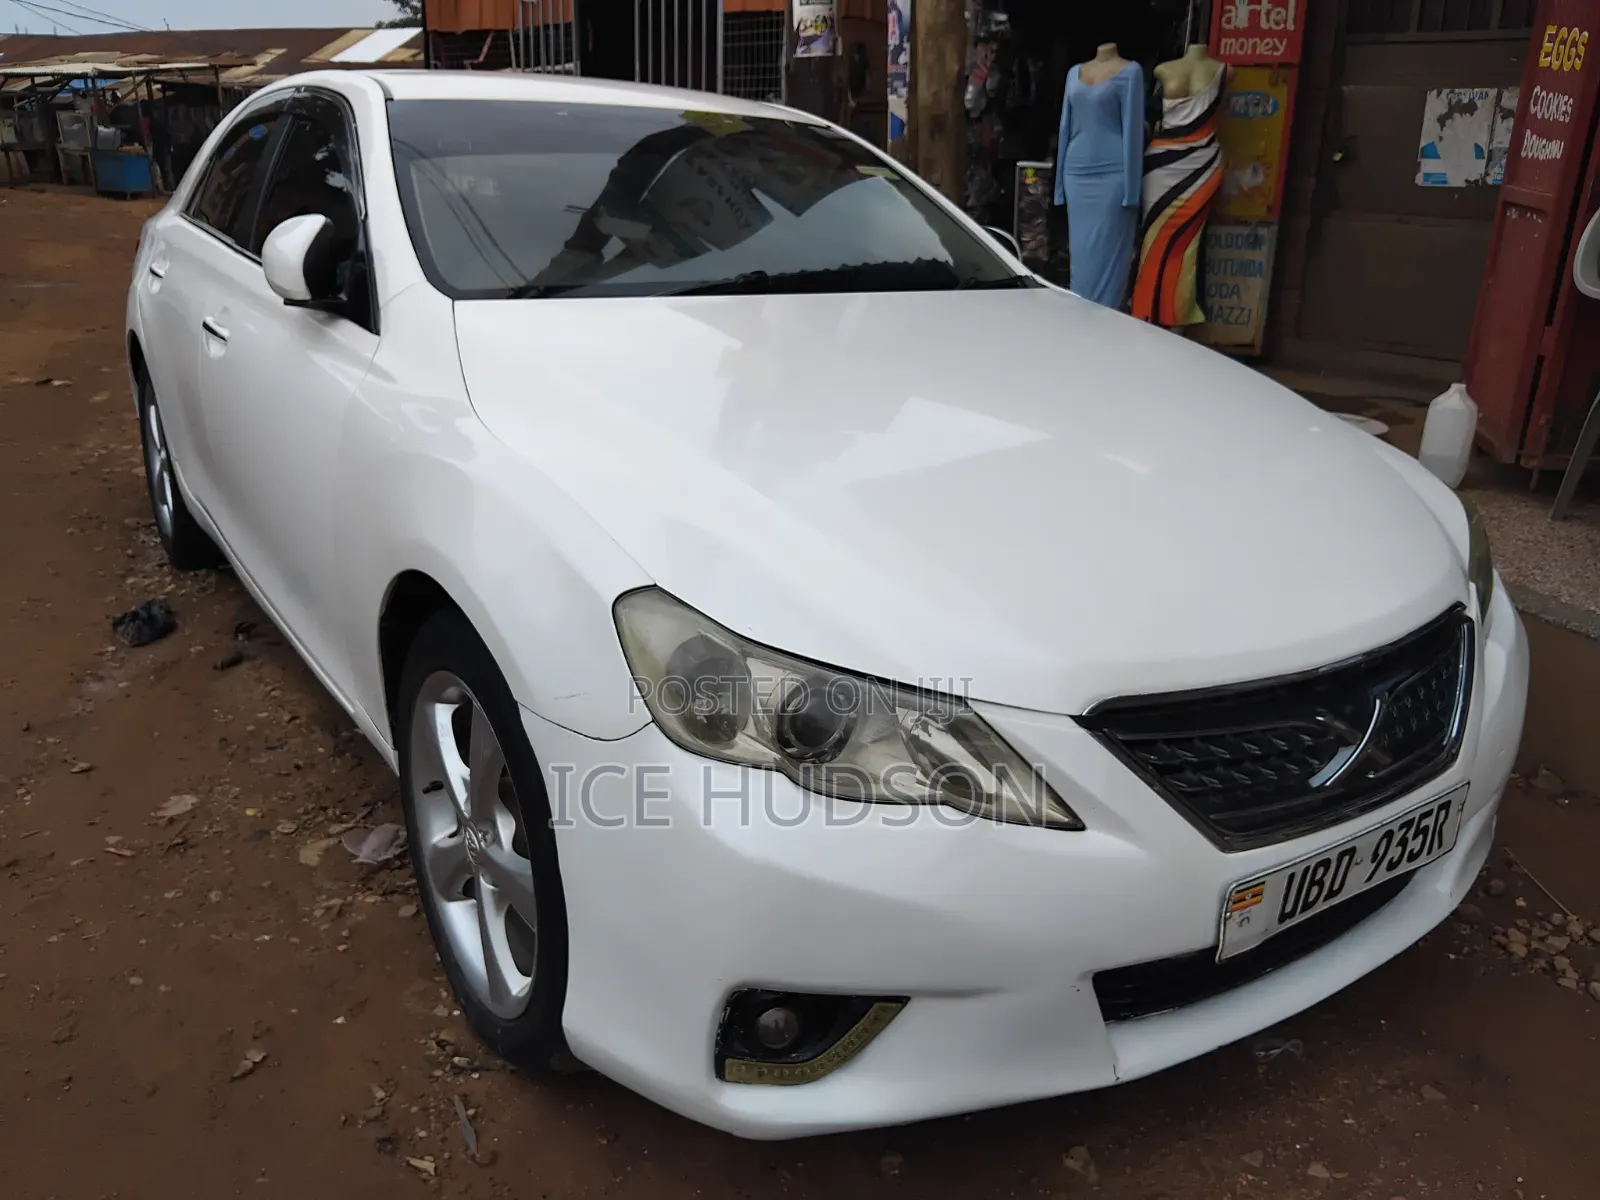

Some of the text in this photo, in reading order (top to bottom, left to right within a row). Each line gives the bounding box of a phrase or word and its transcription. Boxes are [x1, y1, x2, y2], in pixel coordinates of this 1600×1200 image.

[1221, 0, 1295, 31] airtel
[1220, 37, 1287, 56] money
[1538, 24, 1589, 72] EGGS
[1530, 85, 1573, 123] COOKIES
[1206, 283, 1241, 299] ODA
[1277, 799, 1452, 925] UBD 935R
